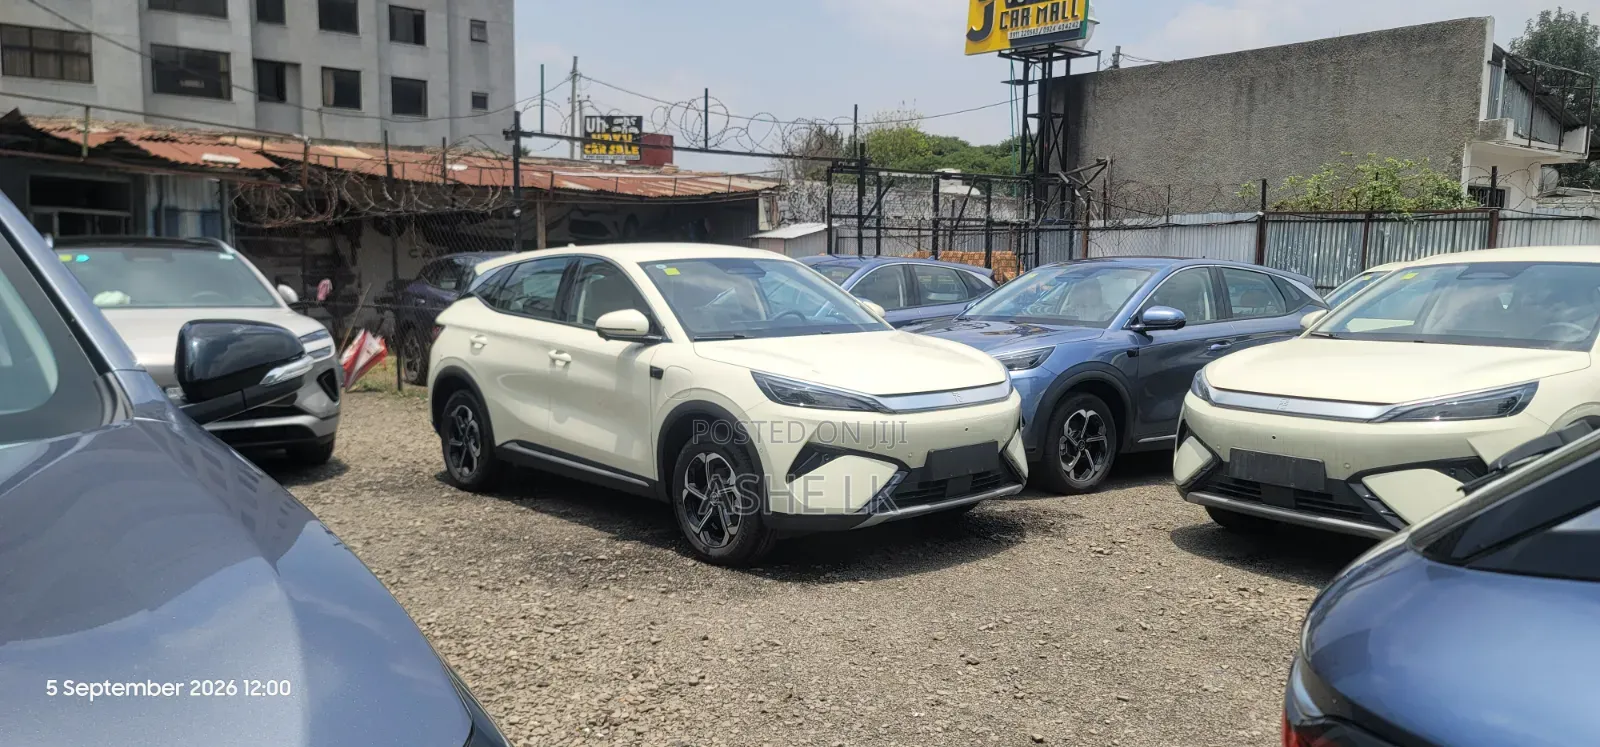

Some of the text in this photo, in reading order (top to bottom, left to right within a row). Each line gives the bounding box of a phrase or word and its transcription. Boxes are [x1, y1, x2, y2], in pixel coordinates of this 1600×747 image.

[1000, 0, 1079, 30] CAR MALL
[584, 143, 640, 155] CAR SALE
